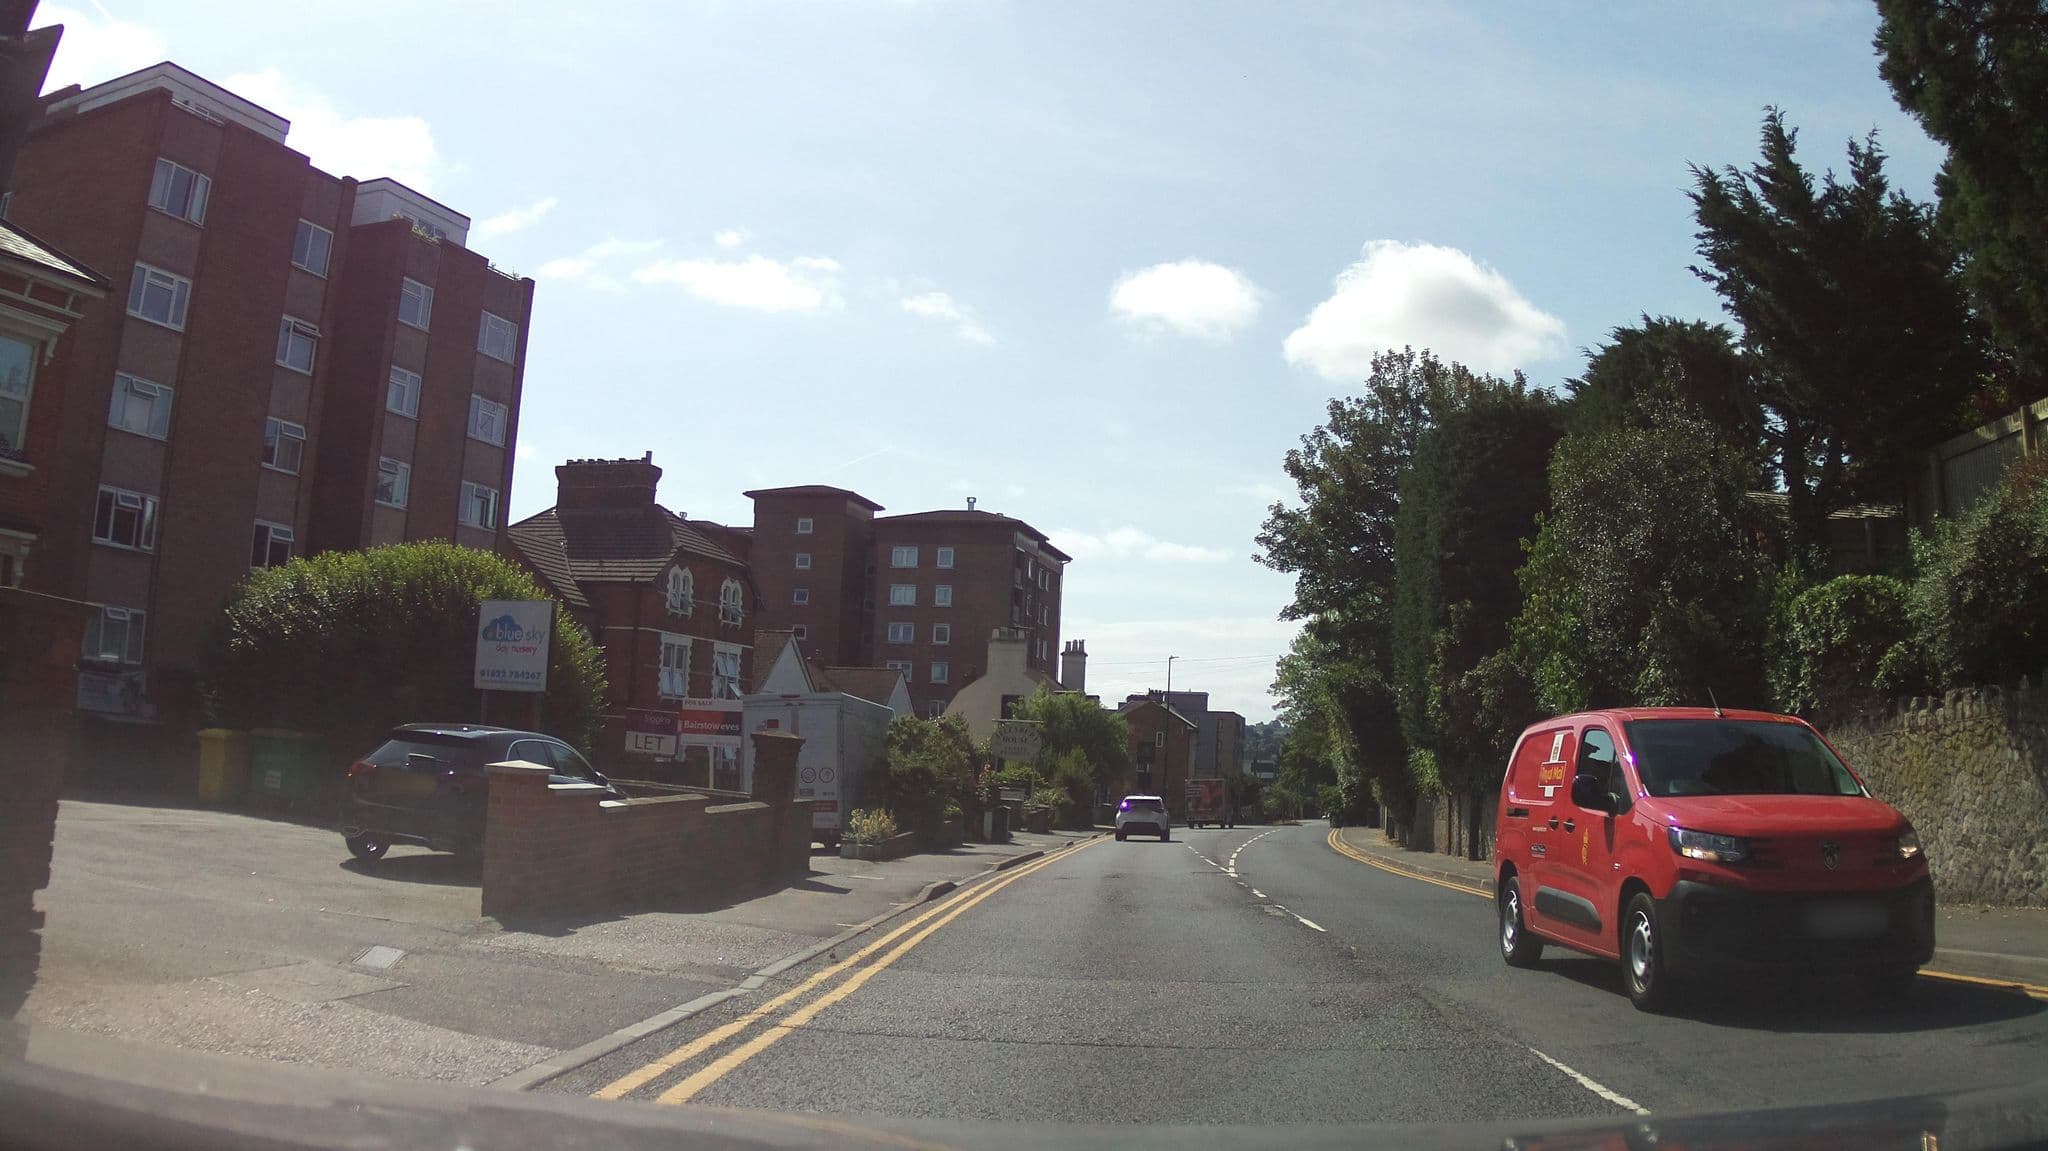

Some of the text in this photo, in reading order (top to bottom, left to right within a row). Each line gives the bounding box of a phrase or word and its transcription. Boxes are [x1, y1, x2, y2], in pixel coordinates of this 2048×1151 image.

[496, 623, 545, 644] blue sky
[635, 734, 665, 751] LET
